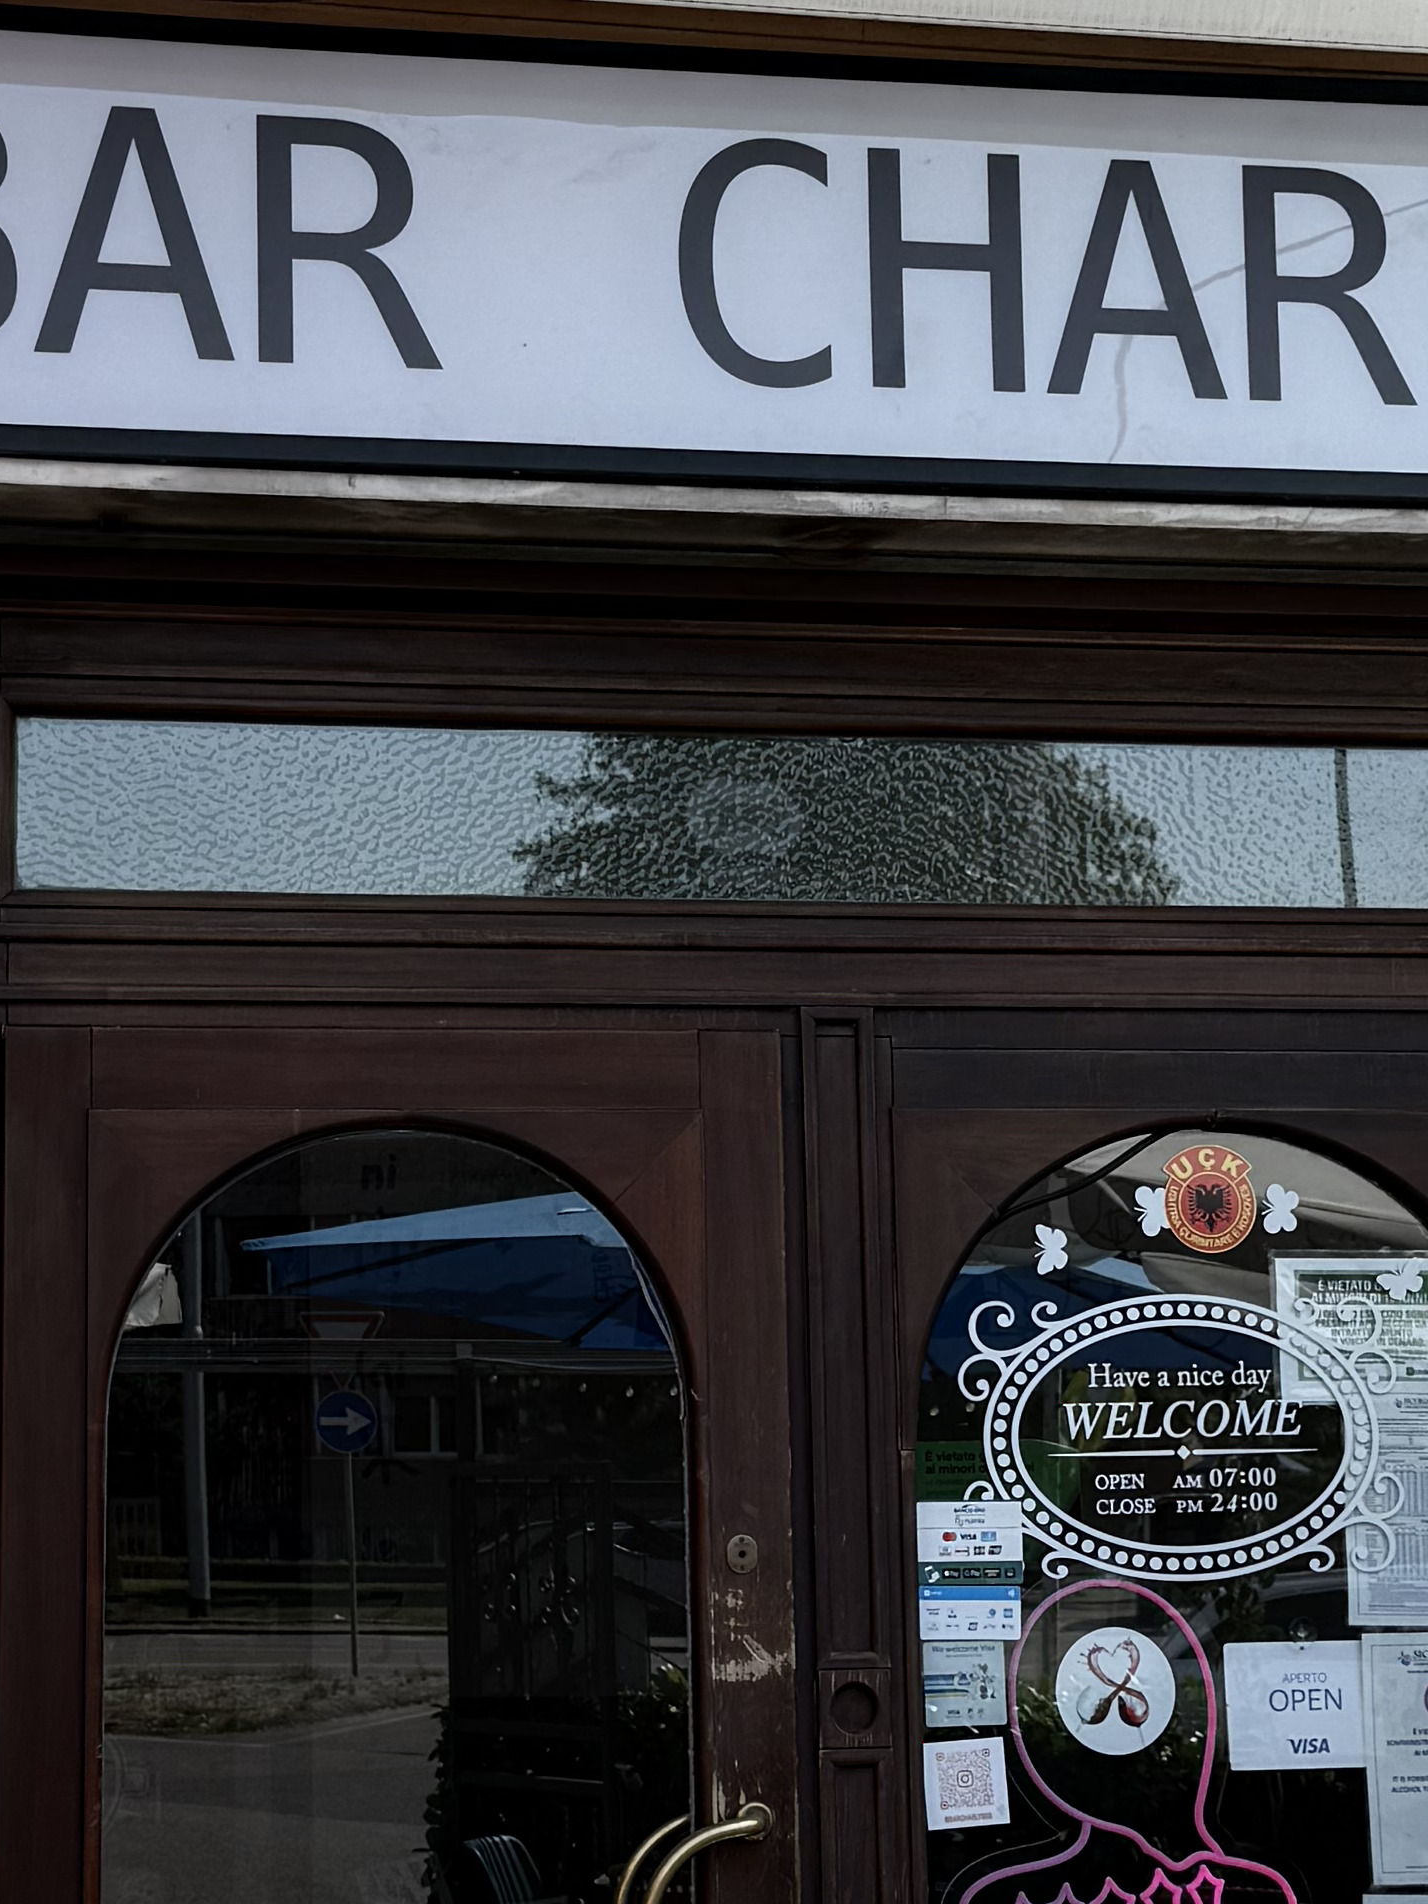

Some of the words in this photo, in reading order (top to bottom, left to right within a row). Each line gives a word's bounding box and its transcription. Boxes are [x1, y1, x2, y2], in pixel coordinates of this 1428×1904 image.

[1171, 1148, 1244, 1179] UÇK
[1327, 1279, 1371, 1292] VIETATO
[1087, 1363, 1151, 1388] Have
[1157, 1373, 1171, 1387] a
[1177, 1363, 1224, 1387] nice
[1231, 1360, 1272, 1393] day
[1062, 1399, 1303, 1440] WELCOME
[938, 1463, 976, 1475] minori
[1095, 1473, 1145, 1491] OPEN
[1173, 1474, 1203, 1489] AM
[1209, 1467, 1277, 1488] 07:00
[1096, 1498, 1156, 1515] CLOSE
[1176, 1500, 1204, 1513] PM
[1210, 1492, 1278, 1513] 24:00
[1282, 1672, 1327, 1684] APERTO
[1269, 1688, 1342, 1712] OPEN
[1287, 1738, 1330, 1754] VISA
